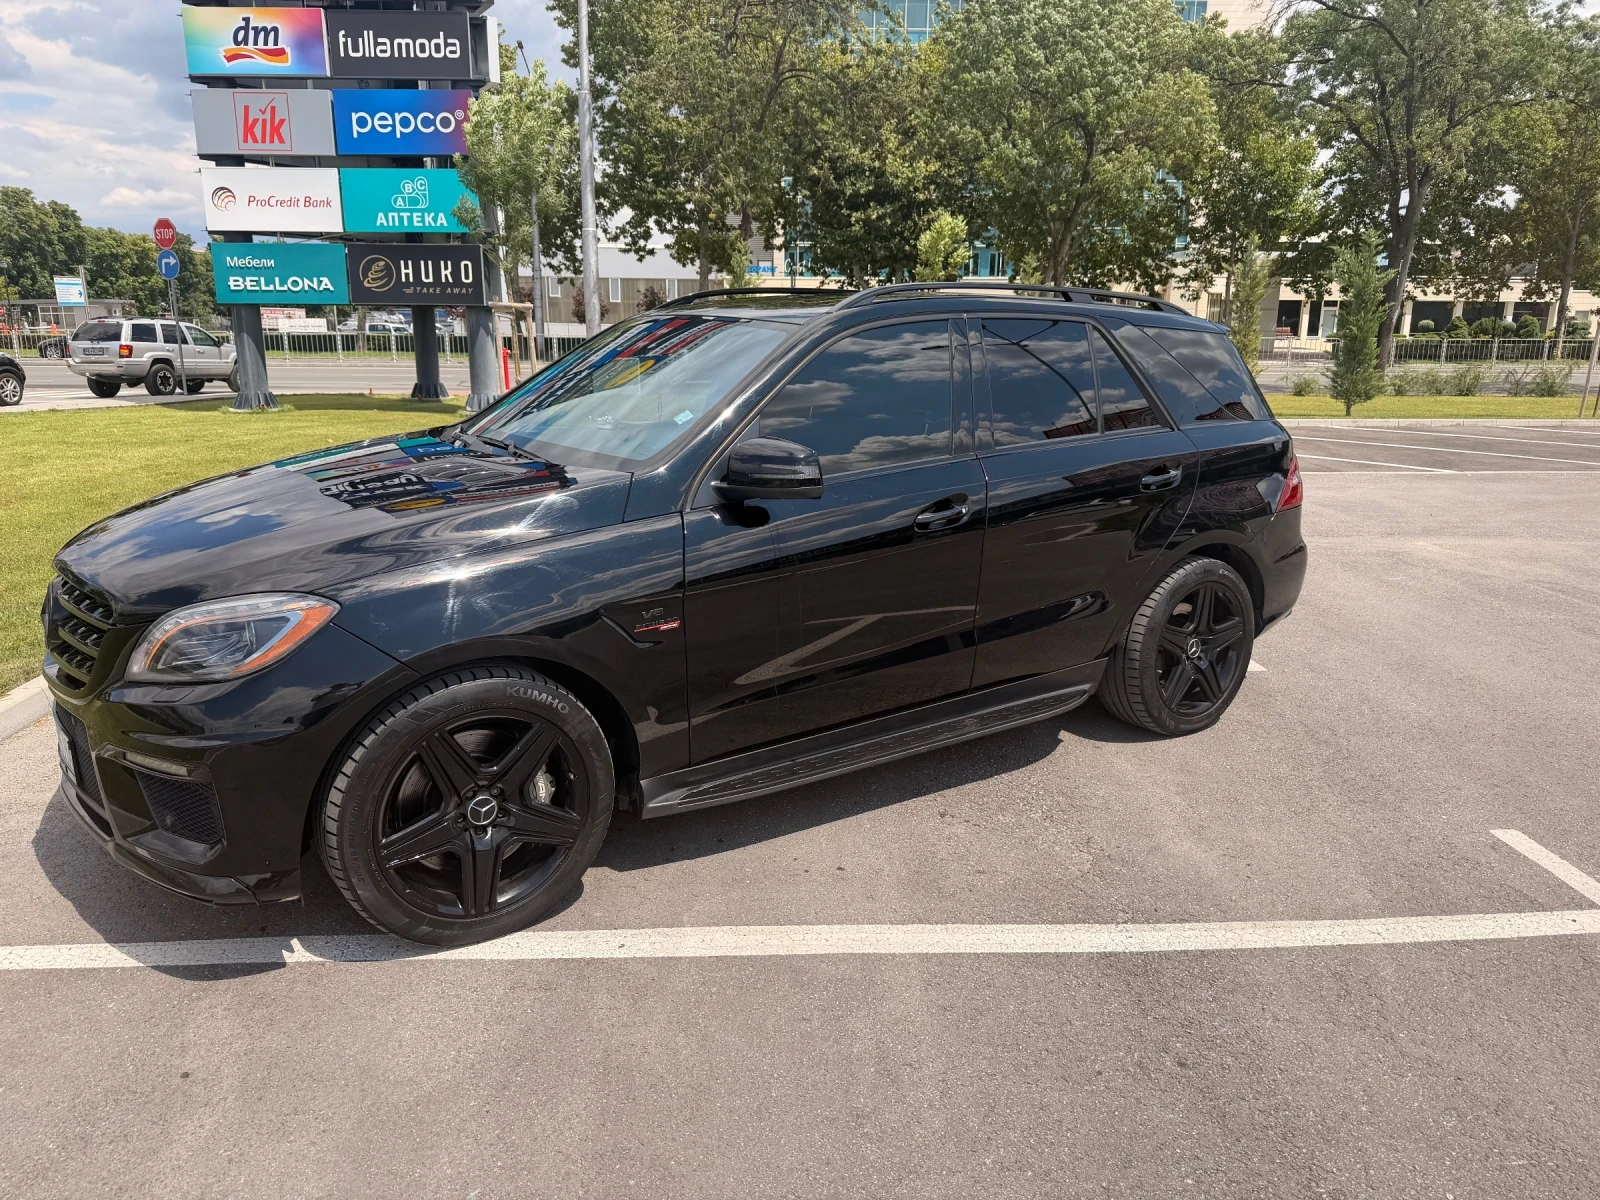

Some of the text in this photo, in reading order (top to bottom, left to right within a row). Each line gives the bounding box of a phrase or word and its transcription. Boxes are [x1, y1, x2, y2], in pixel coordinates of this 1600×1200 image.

[232, 16, 280, 47] dm
[338, 30, 461, 59] fullamoda
[351, 111, 456, 138] pepco
[247, 195, 333, 208] ProCredit Bank
[376, 212, 448, 227] АПТЕКА
[155, 228, 174, 240] STOP
[226, 256, 275, 268] Мебели
[228, 276, 335, 291] BELLONA
[415, 286, 442, 294] TAKE
[506, 686, 570, 714] KUMHO
